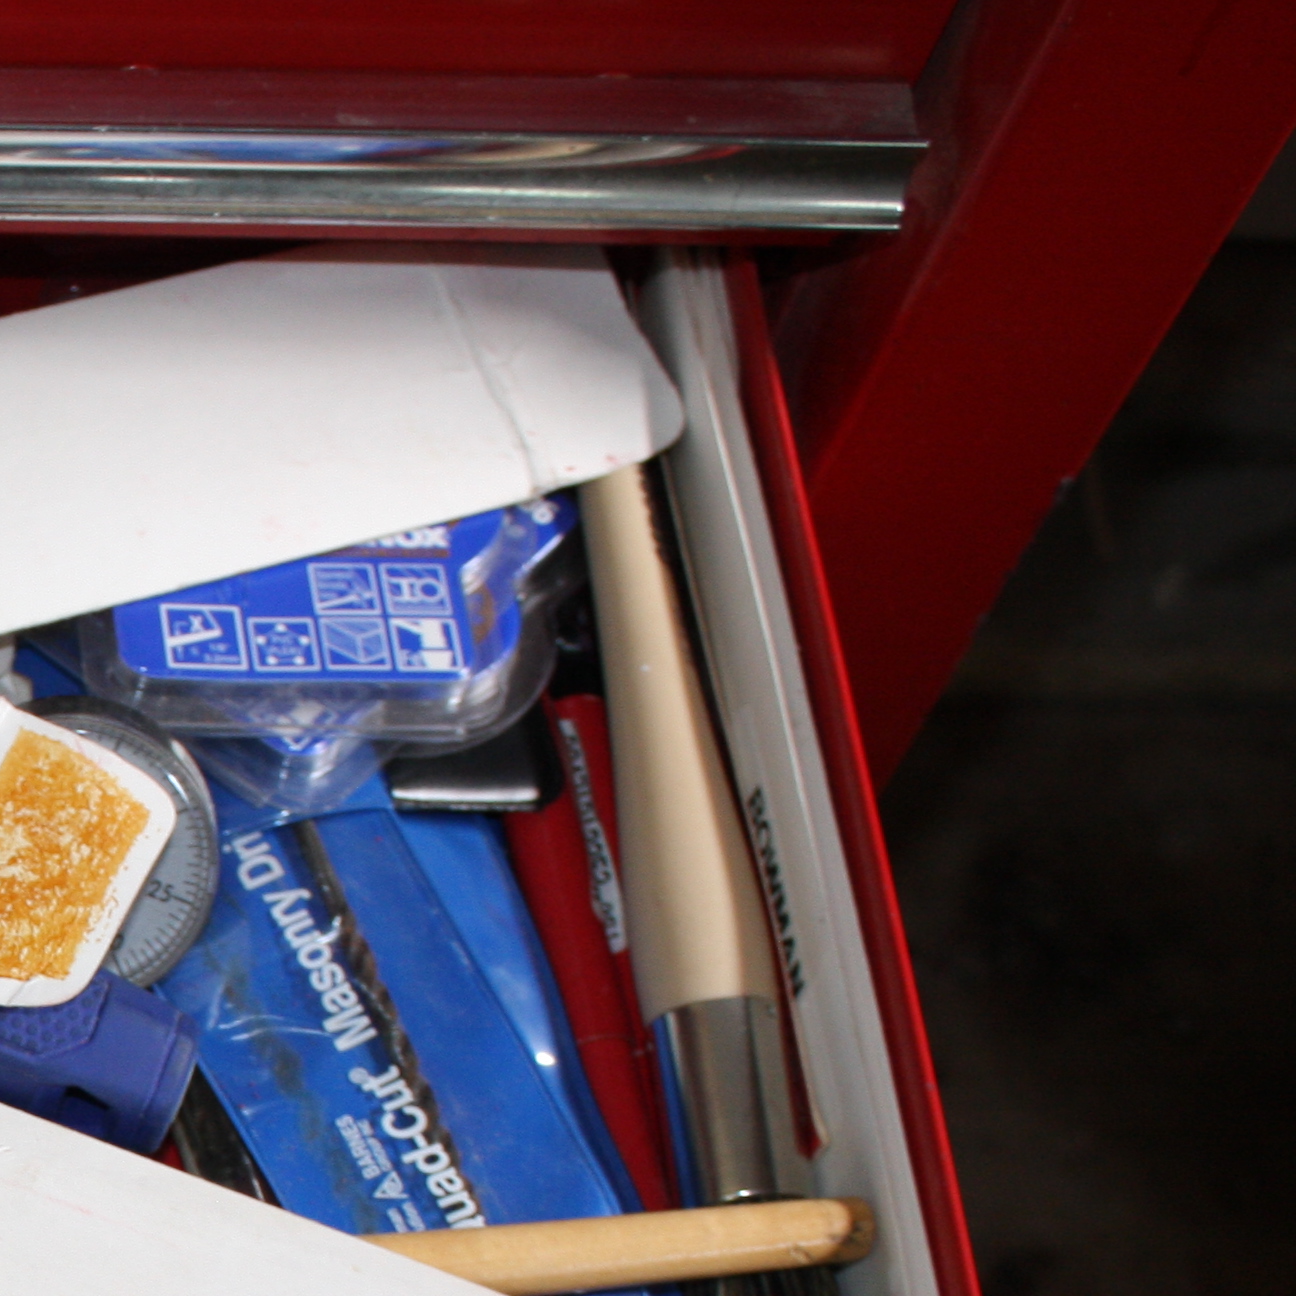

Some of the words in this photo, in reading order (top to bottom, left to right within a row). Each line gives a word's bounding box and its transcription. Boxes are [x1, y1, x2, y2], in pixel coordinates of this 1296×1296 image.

[220, 825, 287, 895] Dri
[750, 786, 805, 997] BOWMAN
[265, 875, 385, 1053] Masonry
[334, 1111, 381, 1181] BARNES
[357, 1062, 485, 1240] uad-Cut
